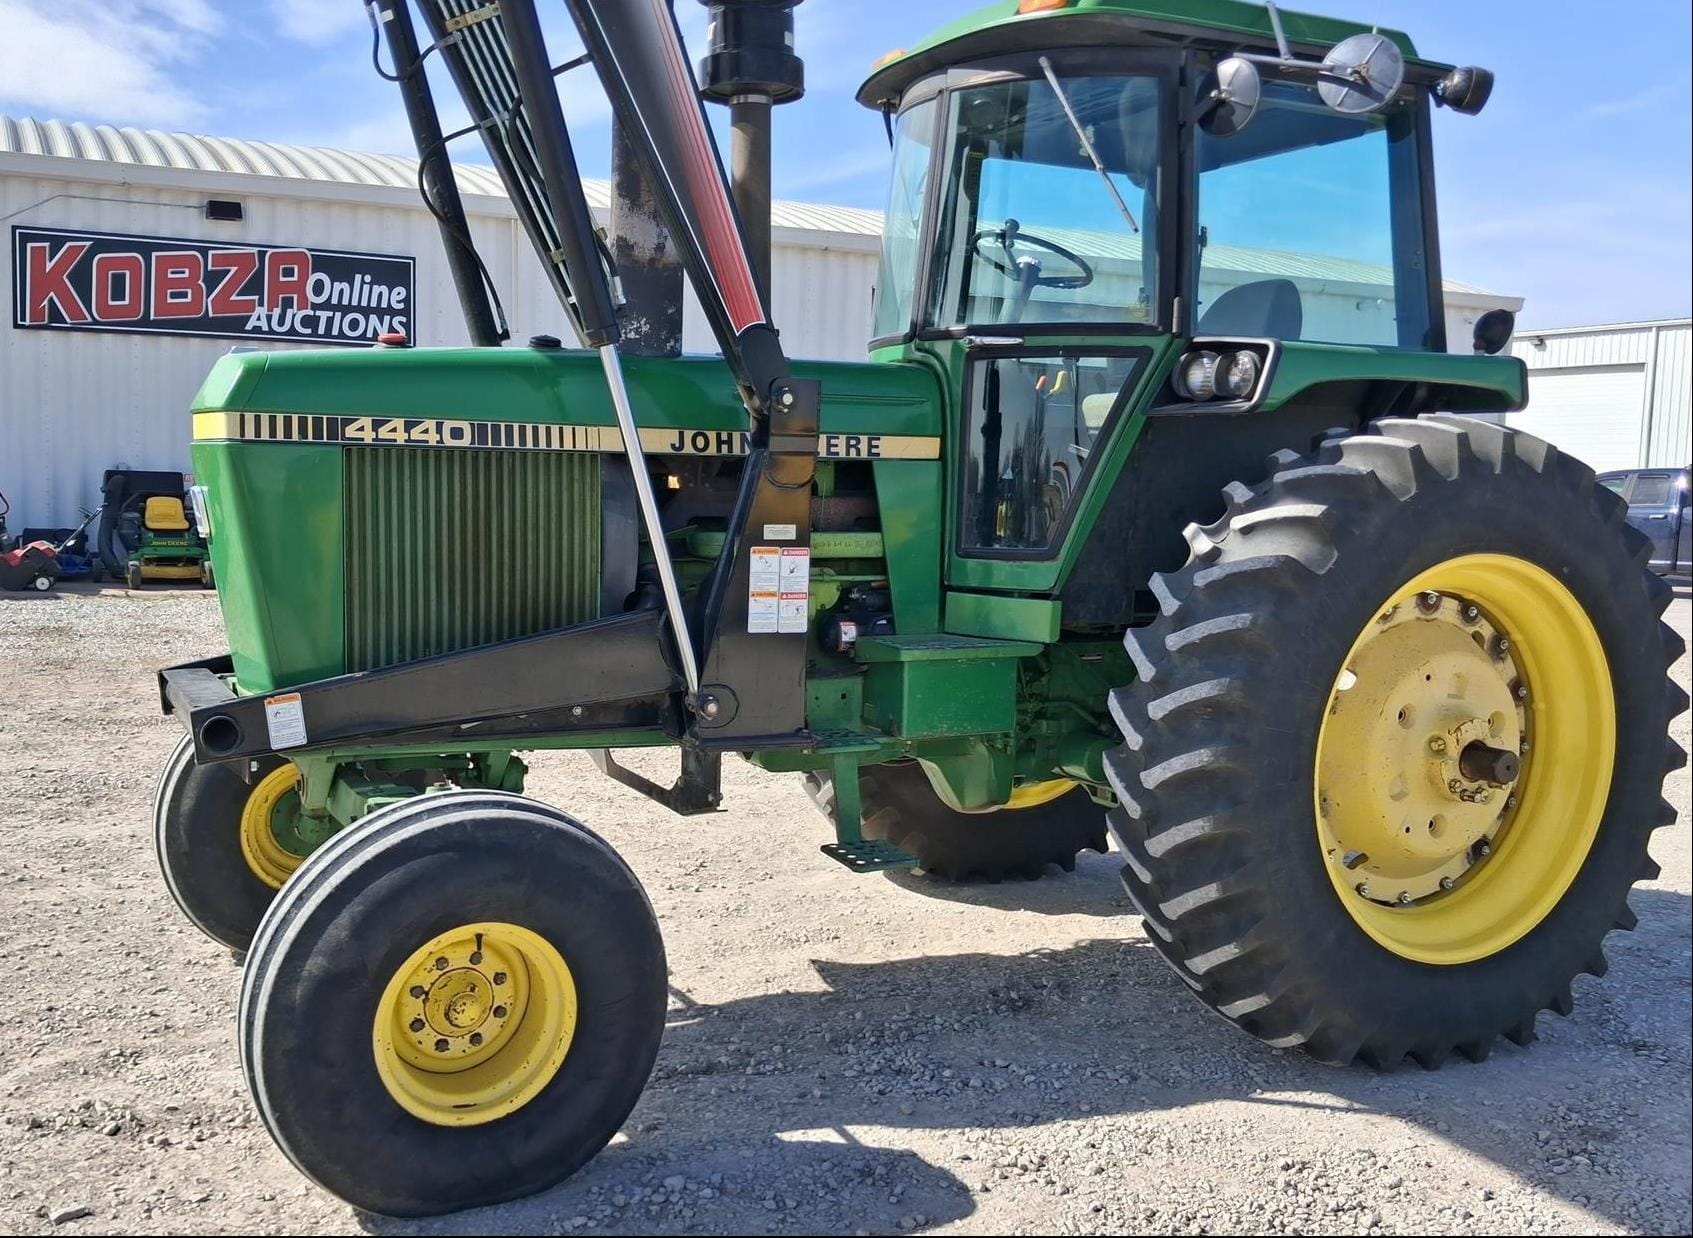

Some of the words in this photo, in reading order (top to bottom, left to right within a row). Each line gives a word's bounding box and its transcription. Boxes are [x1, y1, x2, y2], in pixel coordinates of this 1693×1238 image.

[26, 242, 313, 326] KOBZA
[306, 272, 407, 309] Online
[244, 306, 407, 338] AUCTIONS
[344, 417, 472, 446] 4440
[818, 435, 881, 457] ERE
